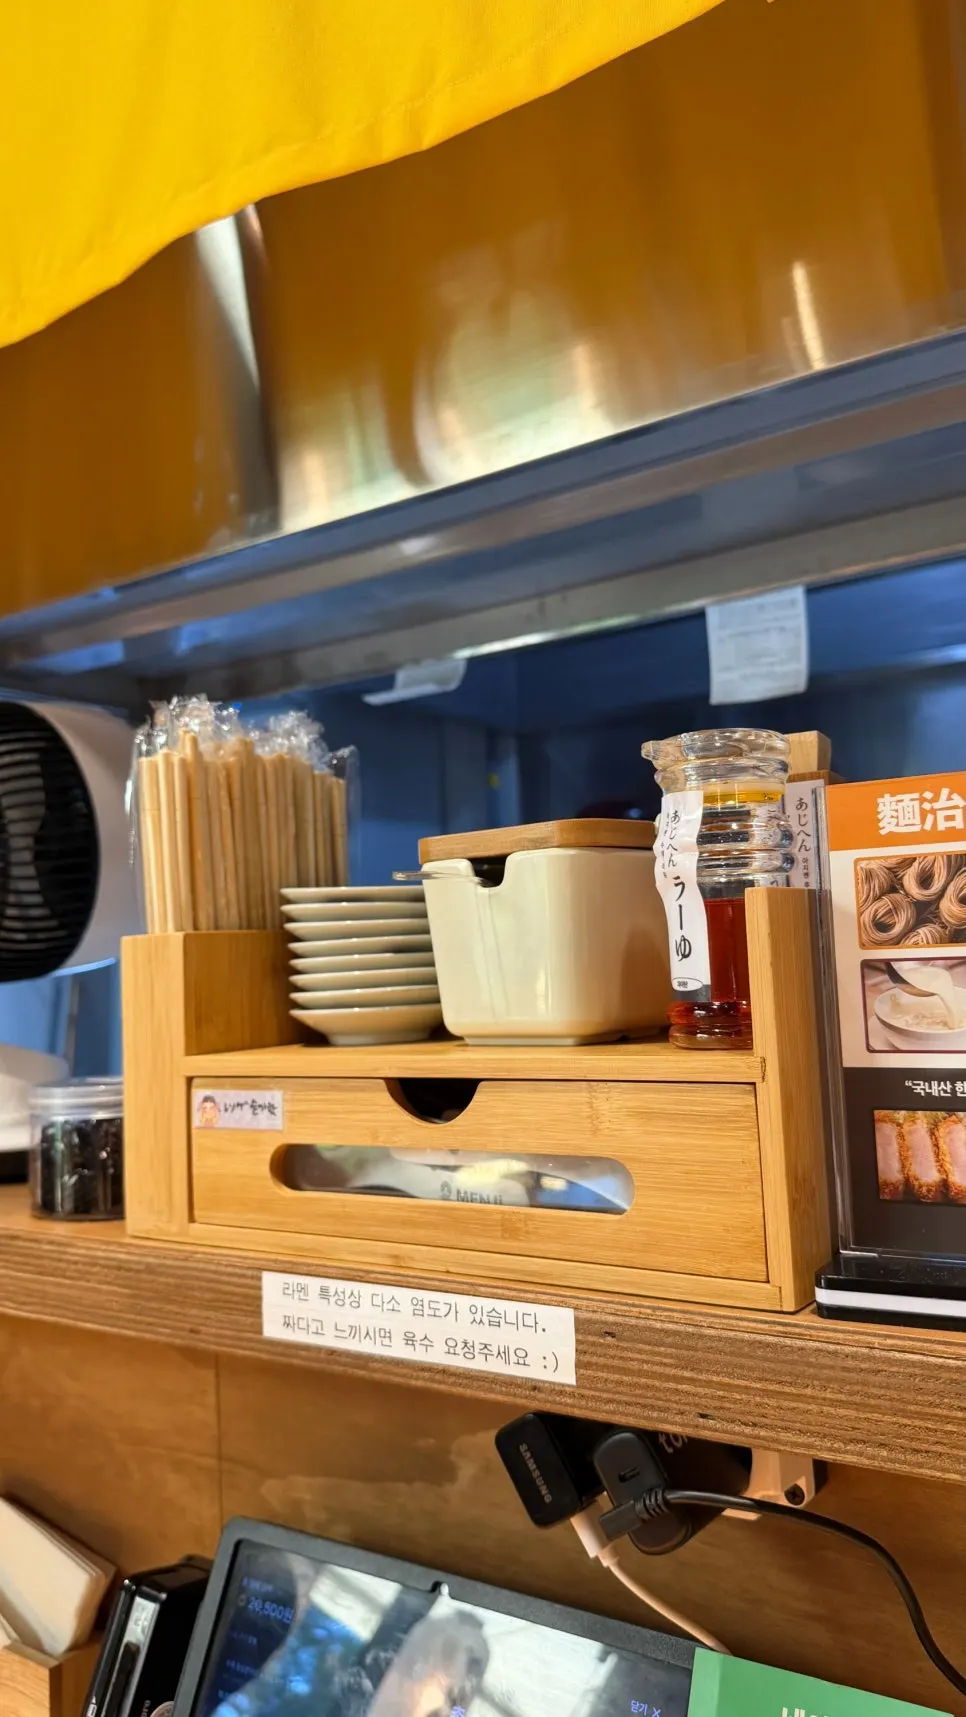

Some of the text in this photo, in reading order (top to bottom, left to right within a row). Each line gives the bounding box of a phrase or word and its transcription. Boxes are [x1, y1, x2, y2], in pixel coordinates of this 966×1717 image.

[666, 810, 680, 868] あじへん
[796, 796, 811, 853] あじへん
[282, 1282, 546, 1333] 라멘 특성상 다소 염도가 있습니다.
[282, 1314, 559, 1373] 짜다고 느끼시면 육수 요청주세요 :)
[519, 1443, 552, 1504] SAMSUNG
